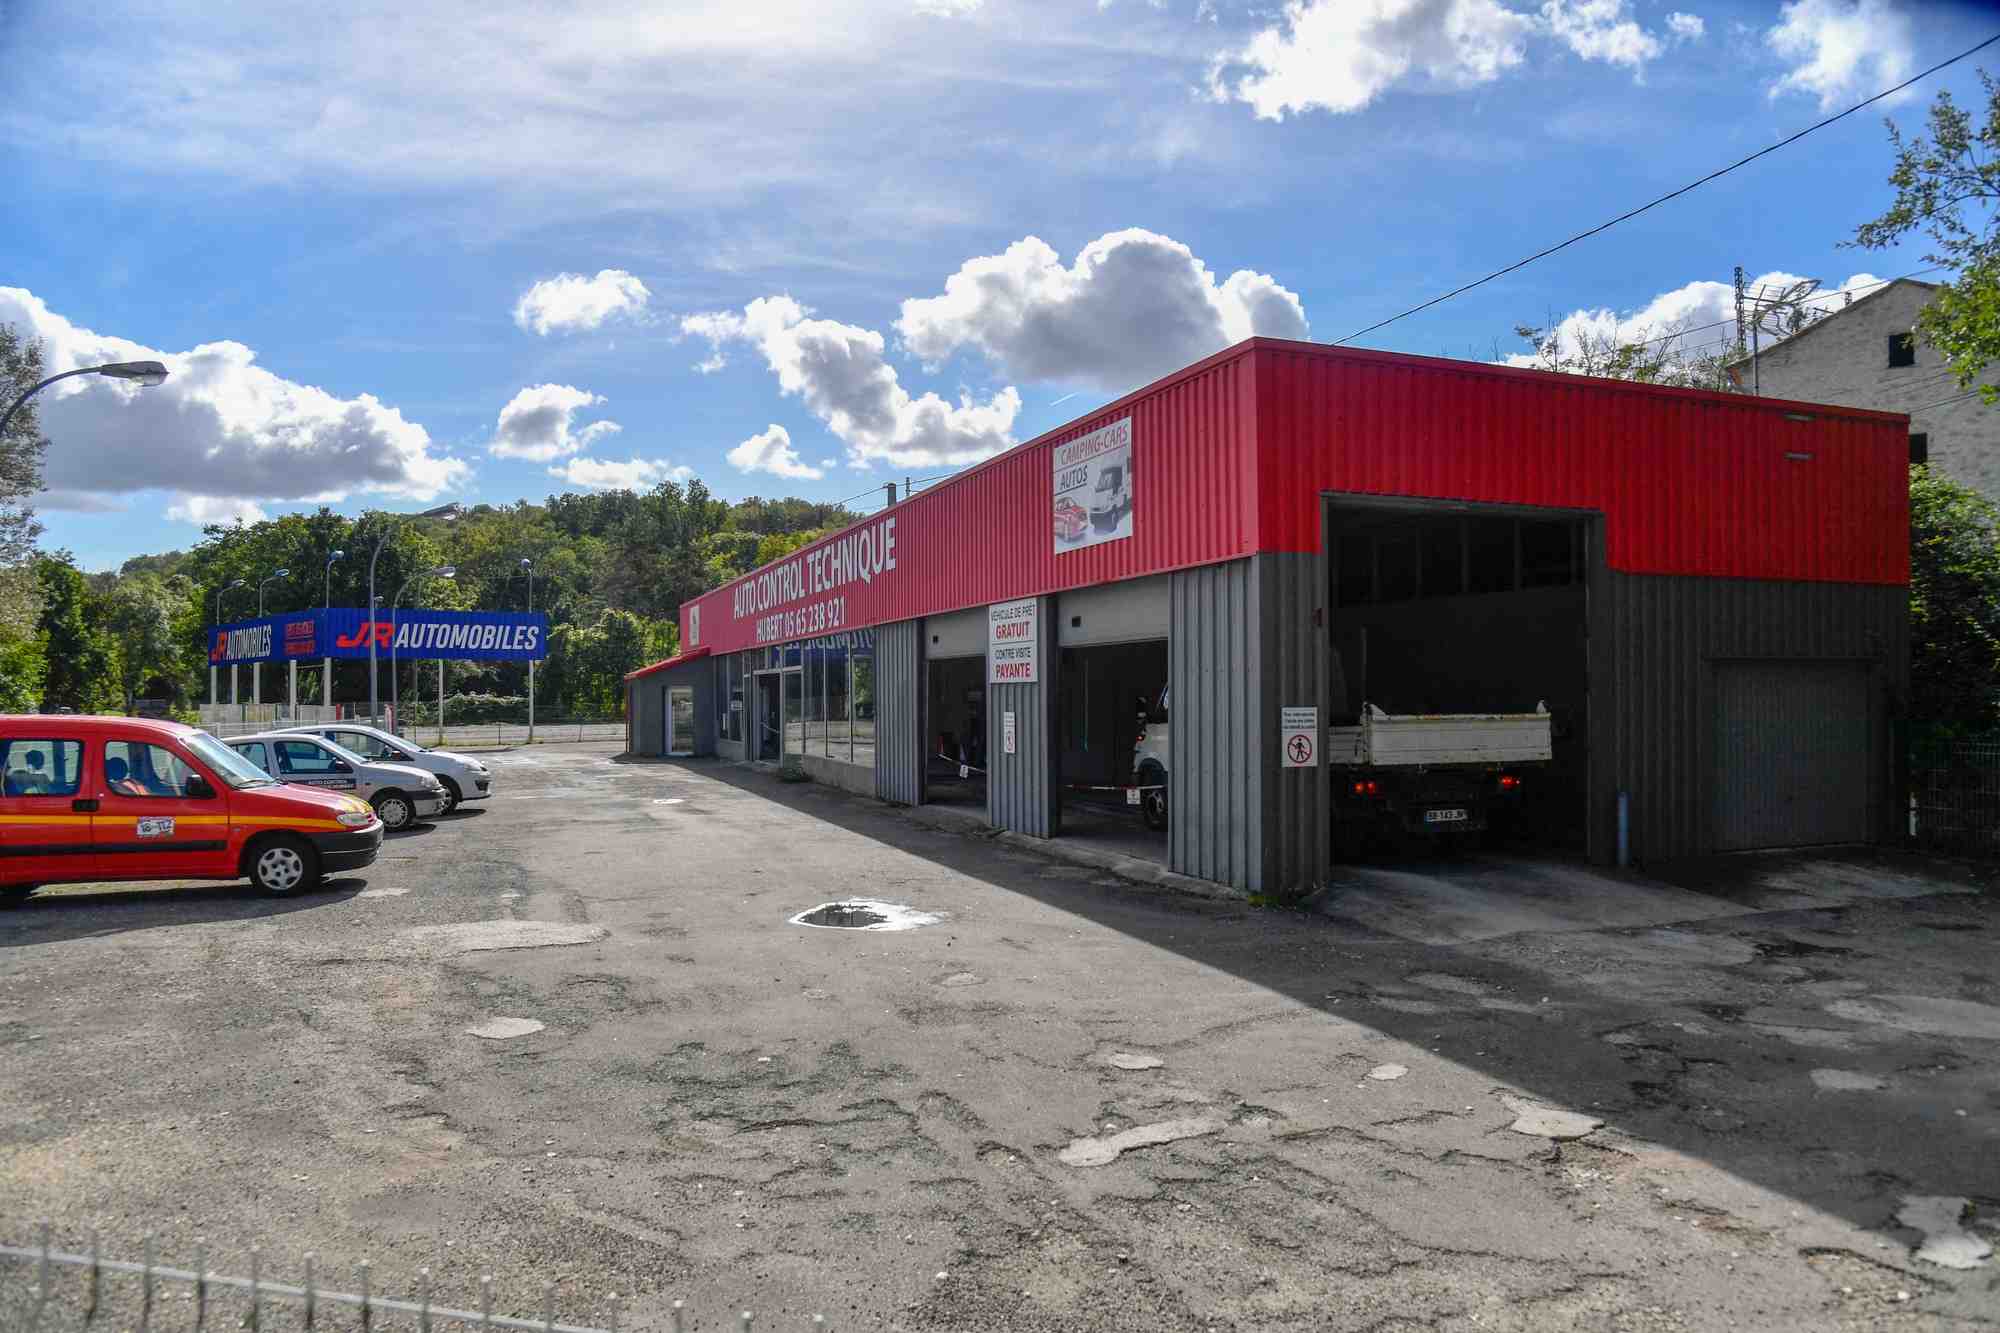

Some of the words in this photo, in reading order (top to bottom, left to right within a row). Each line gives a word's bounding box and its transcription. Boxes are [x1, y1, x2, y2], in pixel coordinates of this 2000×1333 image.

[1060, 424, 1128, 465] CAMPING-CARS
[1060, 464, 1088, 490] AUTOS
[734, 578, 756, 620] AUTO
[757, 558, 805, 612] CONTROL
[806, 516, 897, 594] TECHNIQUE
[756, 613, 784, 643] HUBERT
[784, 610, 795, 637] 05
[796, 606, 807, 635] 65
[808, 601, 825, 632] 238
[827, 596, 846, 628] 921
[995, 621, 1031, 639] GRATUIT
[226, 624, 272, 660] AUTOMOBILES
[394, 623, 540, 650] AUTOMOBILES
[995, 662, 1031, 679] PAYANTE
